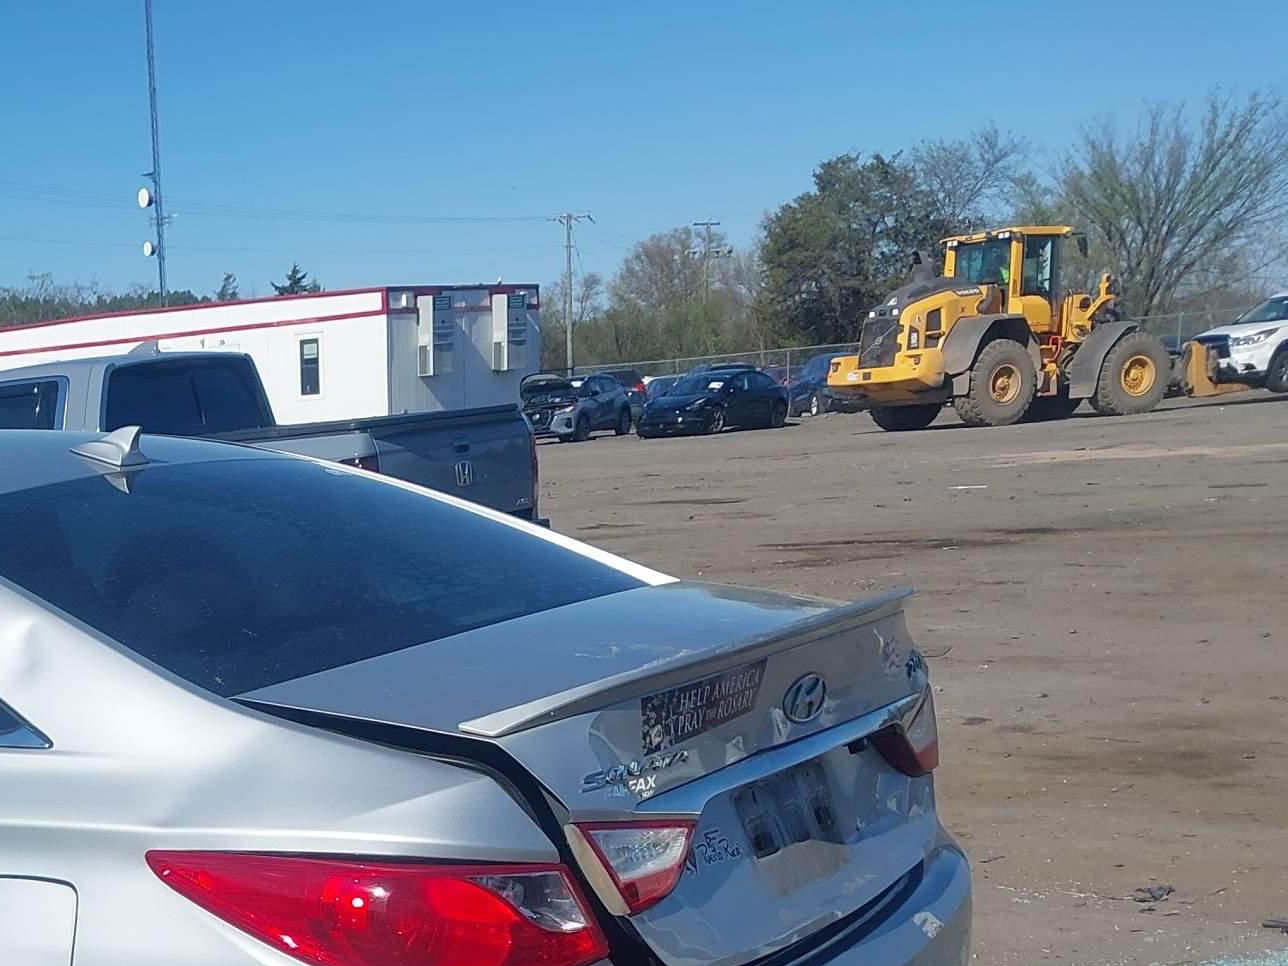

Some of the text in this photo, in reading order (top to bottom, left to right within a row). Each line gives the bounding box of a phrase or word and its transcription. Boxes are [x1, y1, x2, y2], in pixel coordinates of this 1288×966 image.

[677, 707, 705, 736] PRAY
[717, 687, 756, 719] ROSARY
[679, 669, 760, 711] HELP AMERICA
[580, 750, 689, 794] SONATA
